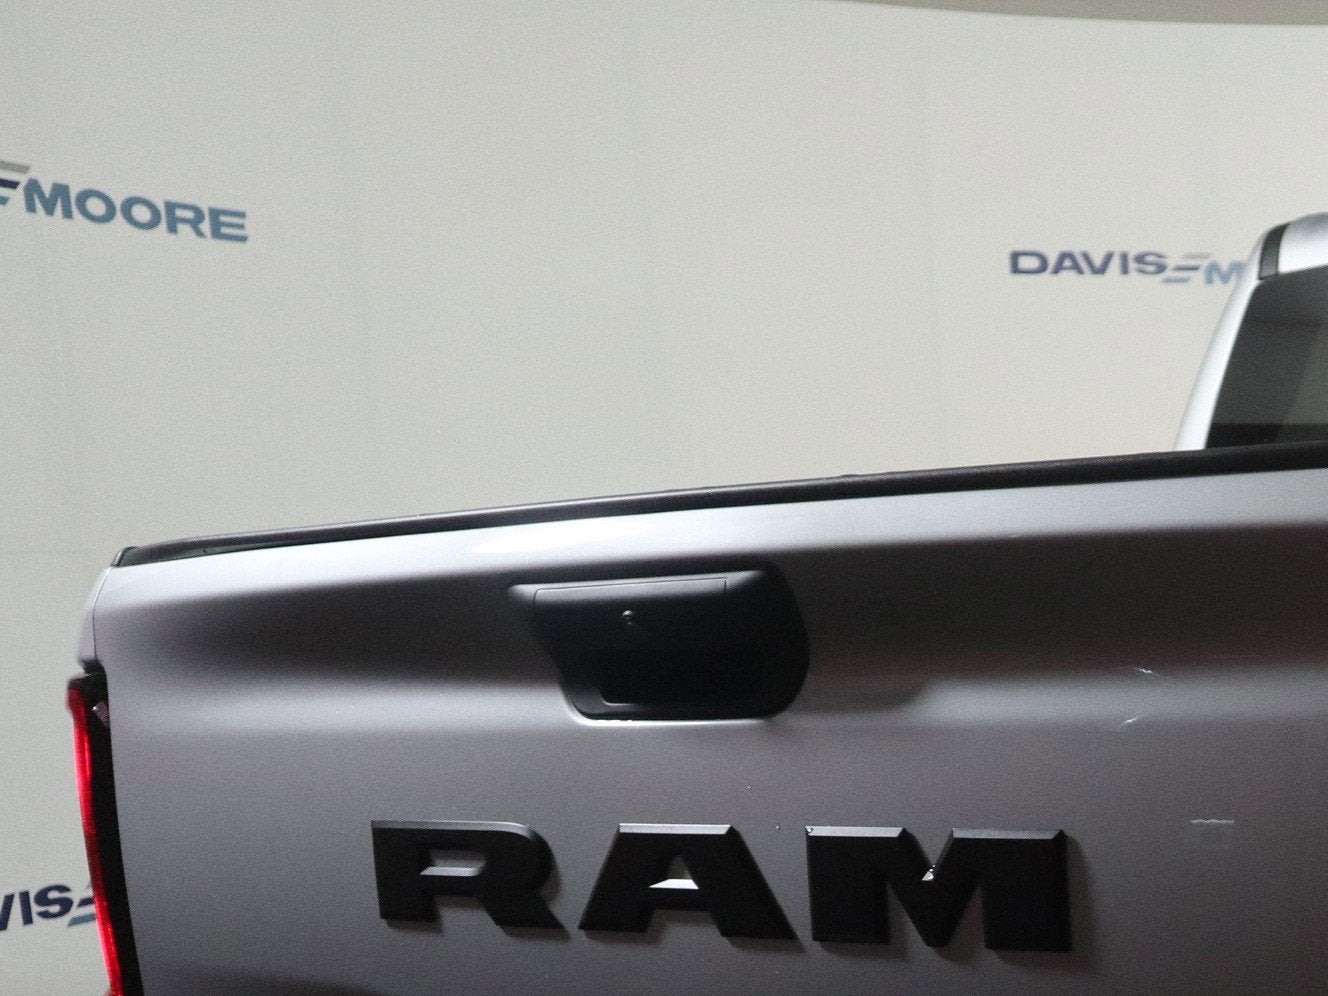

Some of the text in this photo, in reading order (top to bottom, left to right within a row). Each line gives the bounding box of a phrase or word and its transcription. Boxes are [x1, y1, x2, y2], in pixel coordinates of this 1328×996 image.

[23, 177, 249, 243] MOORE
[1009, 250, 1168, 275] DAVIS
[370, 820, 1073, 953] RAM
